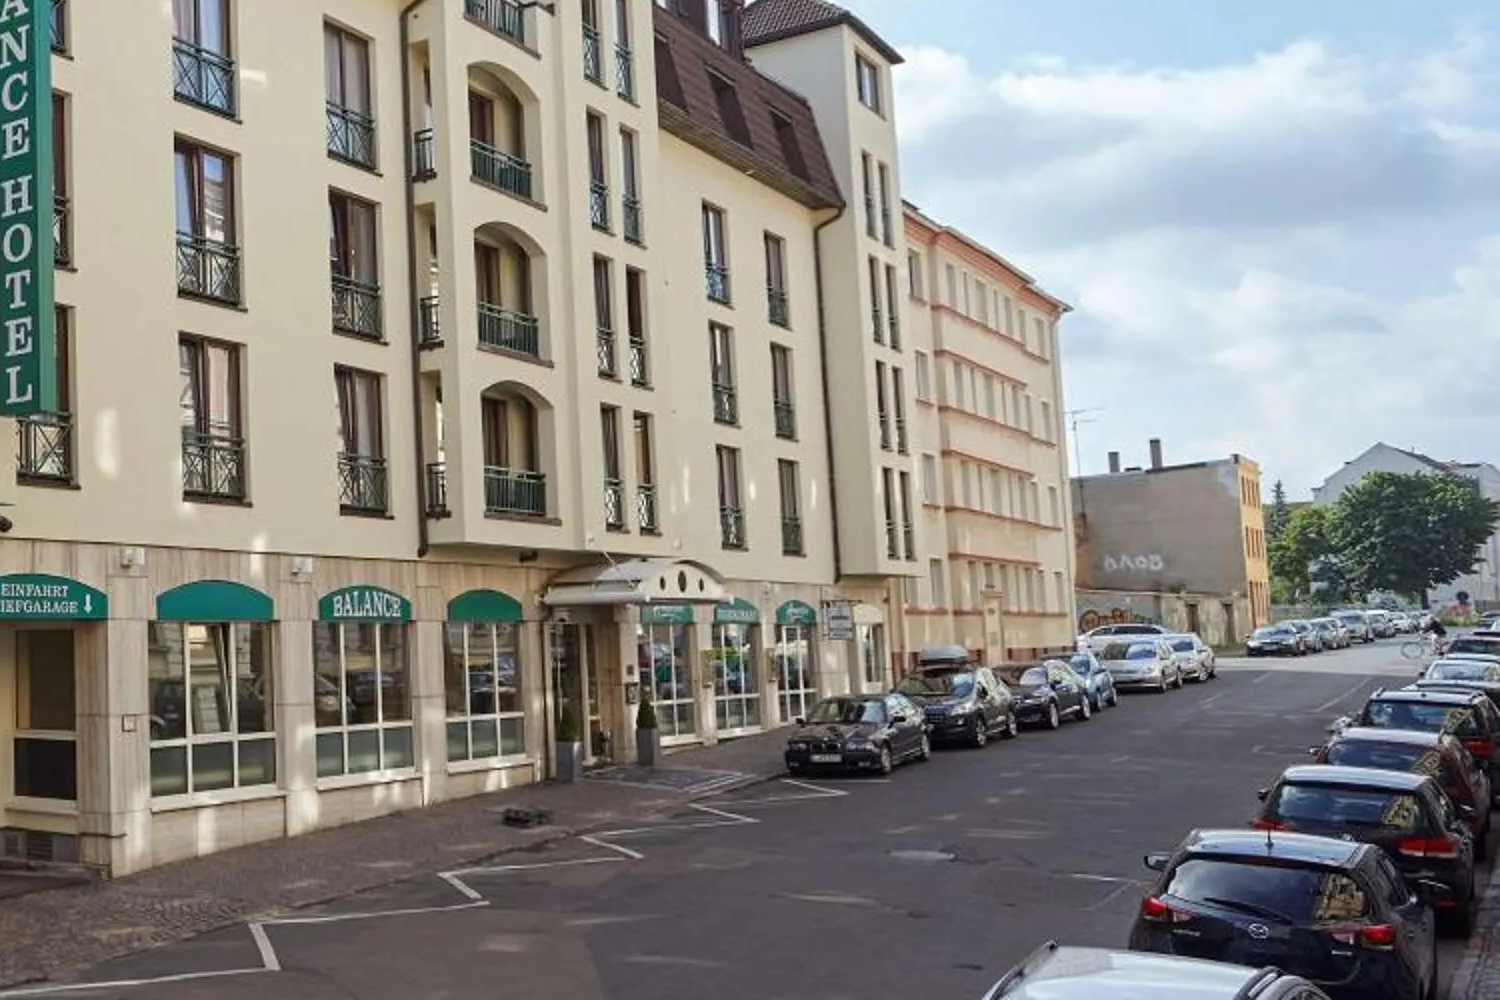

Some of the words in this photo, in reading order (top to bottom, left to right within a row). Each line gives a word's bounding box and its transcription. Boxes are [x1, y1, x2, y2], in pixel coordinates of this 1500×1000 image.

[0, 174, 33, 405] HOTEL
[0, 583, 69, 598] EINFAHRT
[332, 591, 402, 617] BALANCE
